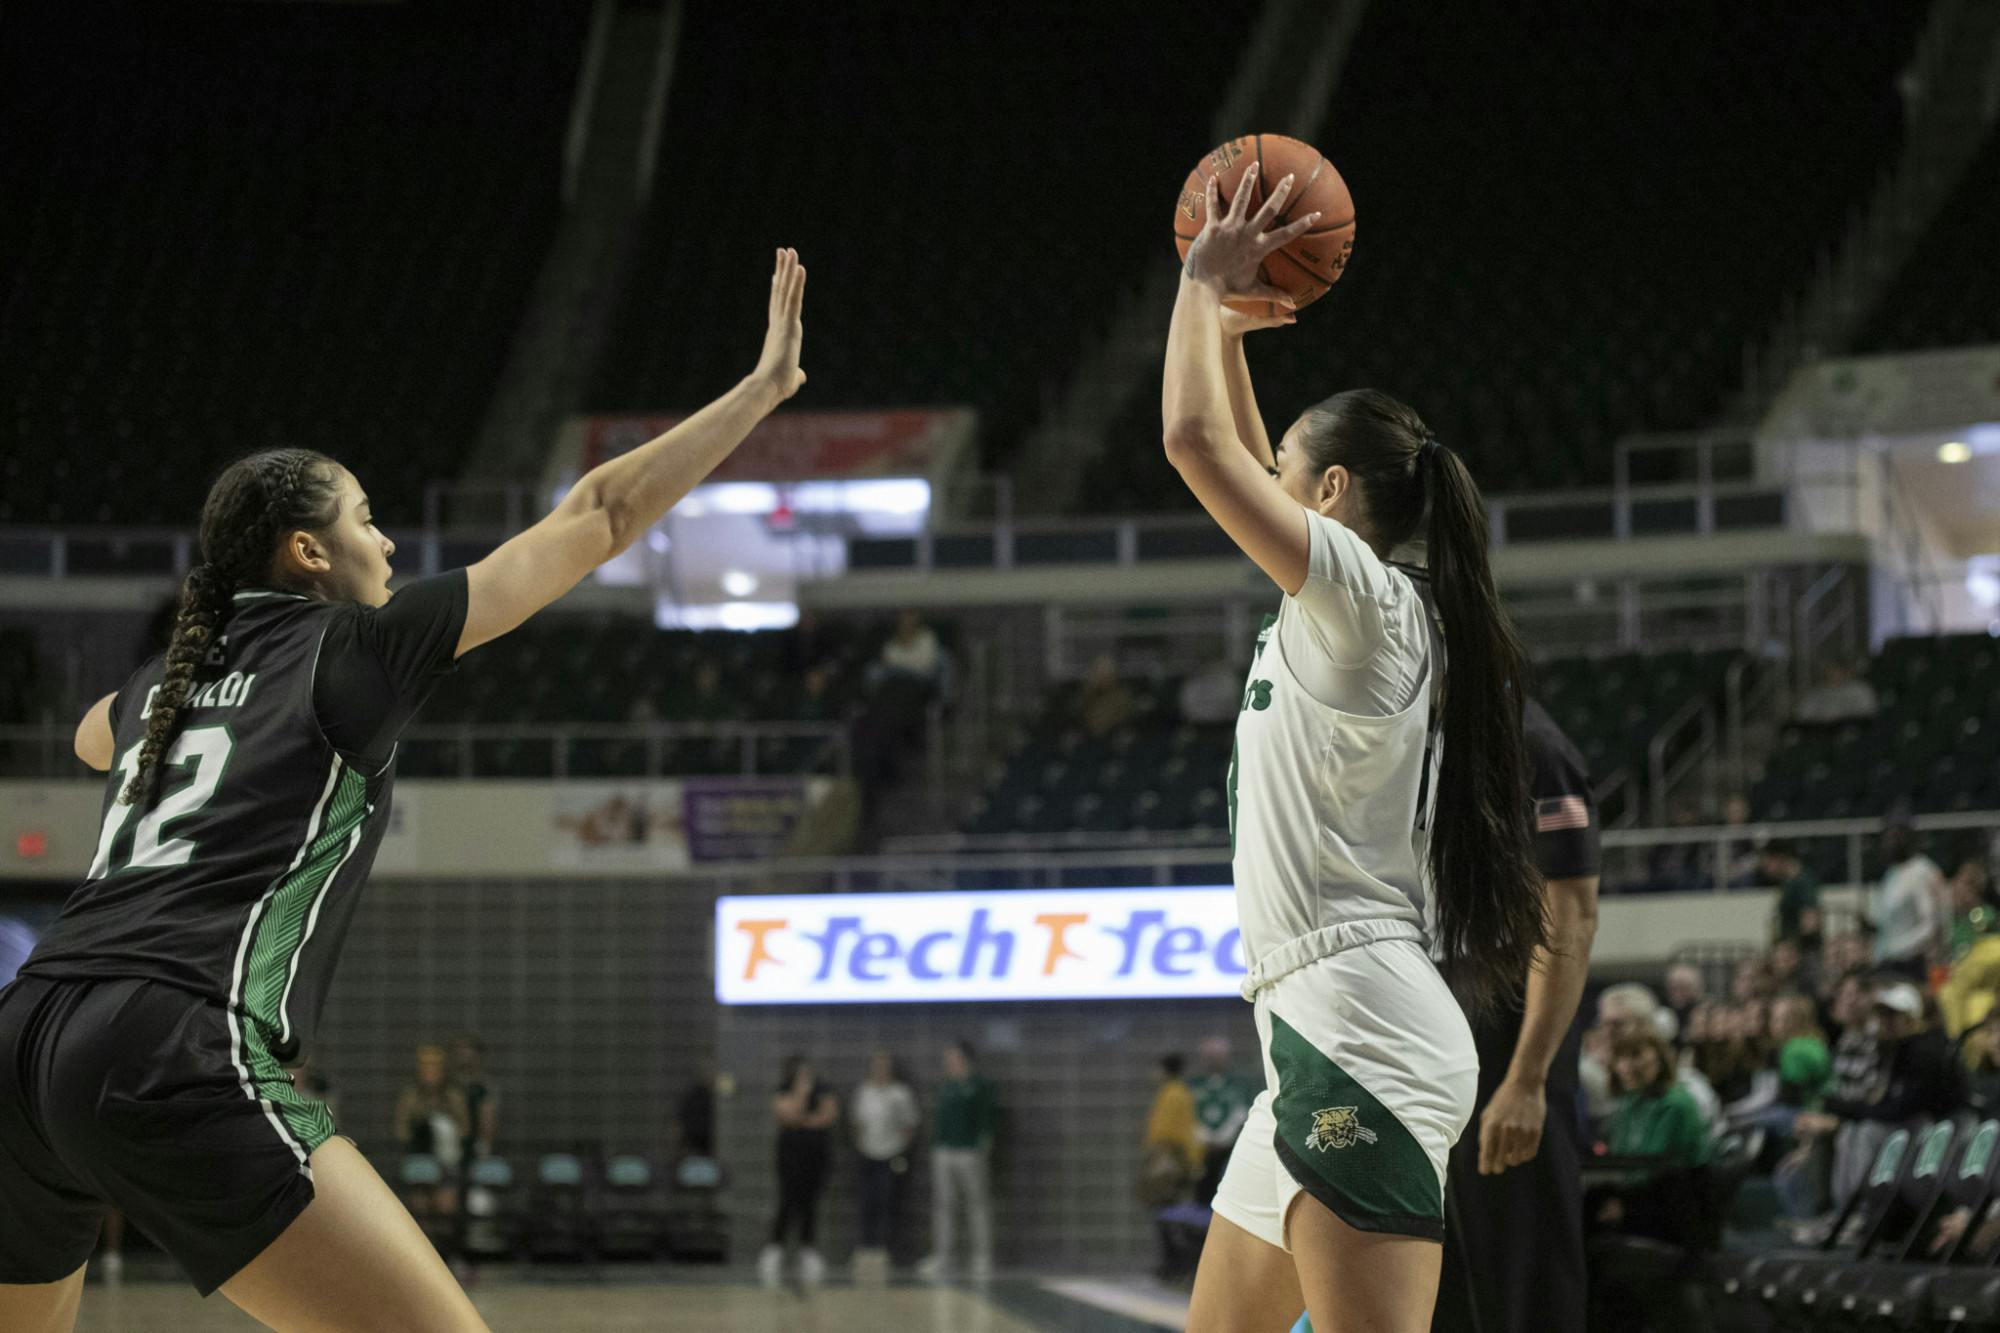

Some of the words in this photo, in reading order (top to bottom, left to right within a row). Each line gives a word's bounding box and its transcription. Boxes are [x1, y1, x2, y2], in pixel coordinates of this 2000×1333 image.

[87, 725, 233, 880] 12
[802, 908, 1015, 981] Tech
[1103, 909, 1249, 976] Tec
